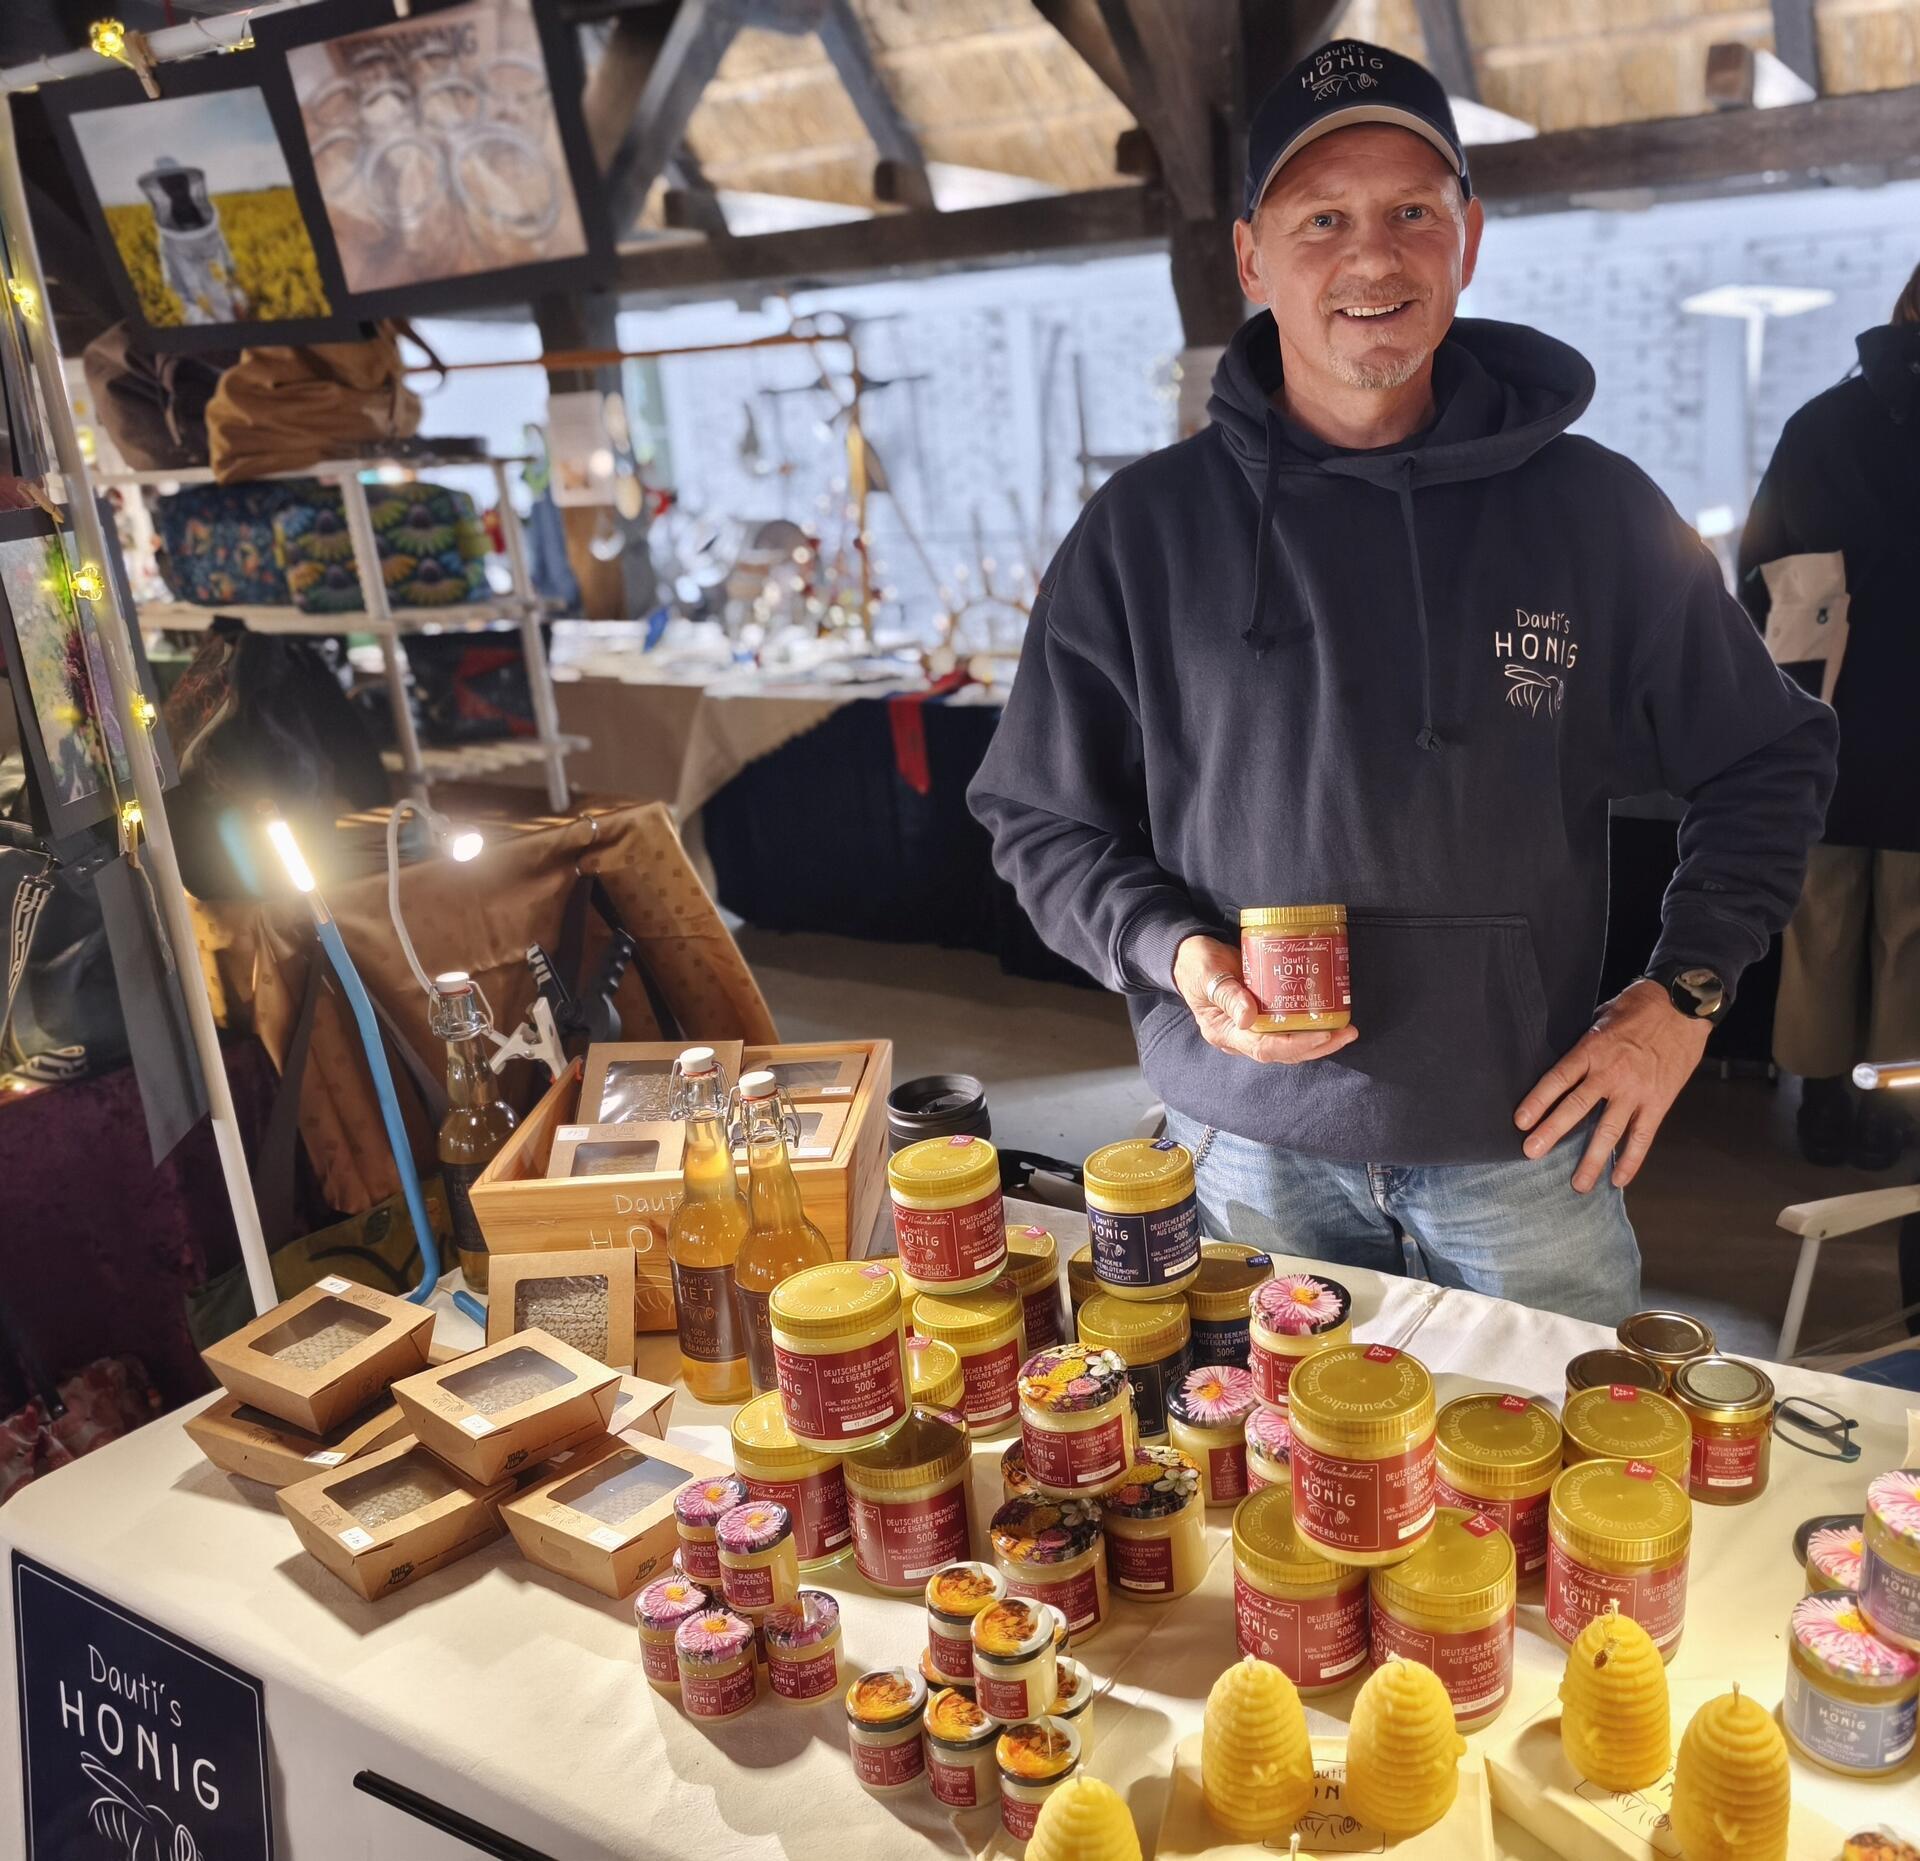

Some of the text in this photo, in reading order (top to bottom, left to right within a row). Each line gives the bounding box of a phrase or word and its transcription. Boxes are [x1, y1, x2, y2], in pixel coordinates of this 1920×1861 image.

[1301, 54, 1384, 89] HONIG
[1516, 608, 1571, 635] Dauti's
[1495, 631, 1579, 669] HONIG
[1282, 955, 1310, 965] Dauti's
[1273, 963, 1320, 976] HONIG
[1284, 1000, 1298, 1009] DER
[960, 1209, 986, 1226] DEUTSCHER
[1095, 1214, 1119, 1228] Dauti's
[1150, 1215, 1179, 1231] DEUTSCHER
[1091, 1222, 1129, 1241] HONIG
[1156, 1221, 1186, 1237] AUS EIGENER
[1174, 1229, 1189, 1243] 500G
[901, 1232, 940, 1247] HONIG
[1216, 1347, 1236, 1357] 500G
[823, 1361, 862, 1378] DEUTSCHER
[831, 1373, 846, 1385] AUS
[846, 1368, 872, 1383] EIGENER
[969, 1370, 993, 1382] EIGENER
[777, 1375, 803, 1396] ONIG
[854, 1378, 877, 1394] 500G
[977, 1380, 996, 1391] 500G
[1321, 1390, 1400, 1414] Deutscher
[1640, 1396, 1674, 1431] Original
[1526, 1410, 1547, 1449] Original
[1026, 1441, 1056, 1460] HONIG
[1463, 1440, 1534, 1459] Deutscher
[1724, 1457, 1740, 1465] 250G
[1385, 1461, 1419, 1483] DEUTSCHER
[1309, 1471, 1343, 1492] Dauti's
[1392, 1476, 1405, 1488] AUS
[1413, 1477, 1430, 1495] 500G
[750, 1485, 795, 1500] Weihnachten
[814, 1495, 827, 1504] AUS
[1301, 1475, 1357, 1507] HONIG
[1651, 1480, 1674, 1522] Original
[886, 1513, 925, 1527] DEUTSCHER
[893, 1525, 907, 1534] AUS
[907, 1521, 934, 1533] EIGENER
[1583, 1508, 1662, 1531] Deutscher
[916, 1530, 939, 1544] 500G
[1300, 1514, 1361, 1544] SOMMERBLÜTE
[1568, 1578, 1600, 1600] Dauti's
[1642, 1578, 1677, 1597] DEUTSCHER
[1559, 1581, 1614, 1615] HONIG
[1649, 1591, 1662, 1603] AUS
[1237, 1601, 1279, 1641] HONIG
[1241, 1600, 1268, 1625] Dauti's
[1306, 1608, 1347, 1624] DEUTSCHER
[1314, 1611, 1354, 1630] AUS EIGENER
[1336, 1624, 1357, 1639] 500G
[936, 1651, 968, 1666] HONIG
[1441, 1643, 1483, 1657] DEUTSCHER
[1448, 1650, 1492, 1664] AUS EIGENER
[1471, 1660, 1495, 1676] 500G
[87, 1643, 182, 1728] Dauti's
[771, 1672, 796, 1687] HONIG
[687, 1692, 717, 1706] HONIG
[1818, 1706, 1867, 1731] HONIG
[59, 1680, 220, 1811] HONIG
[1004, 1811, 1034, 1830] HONIG
